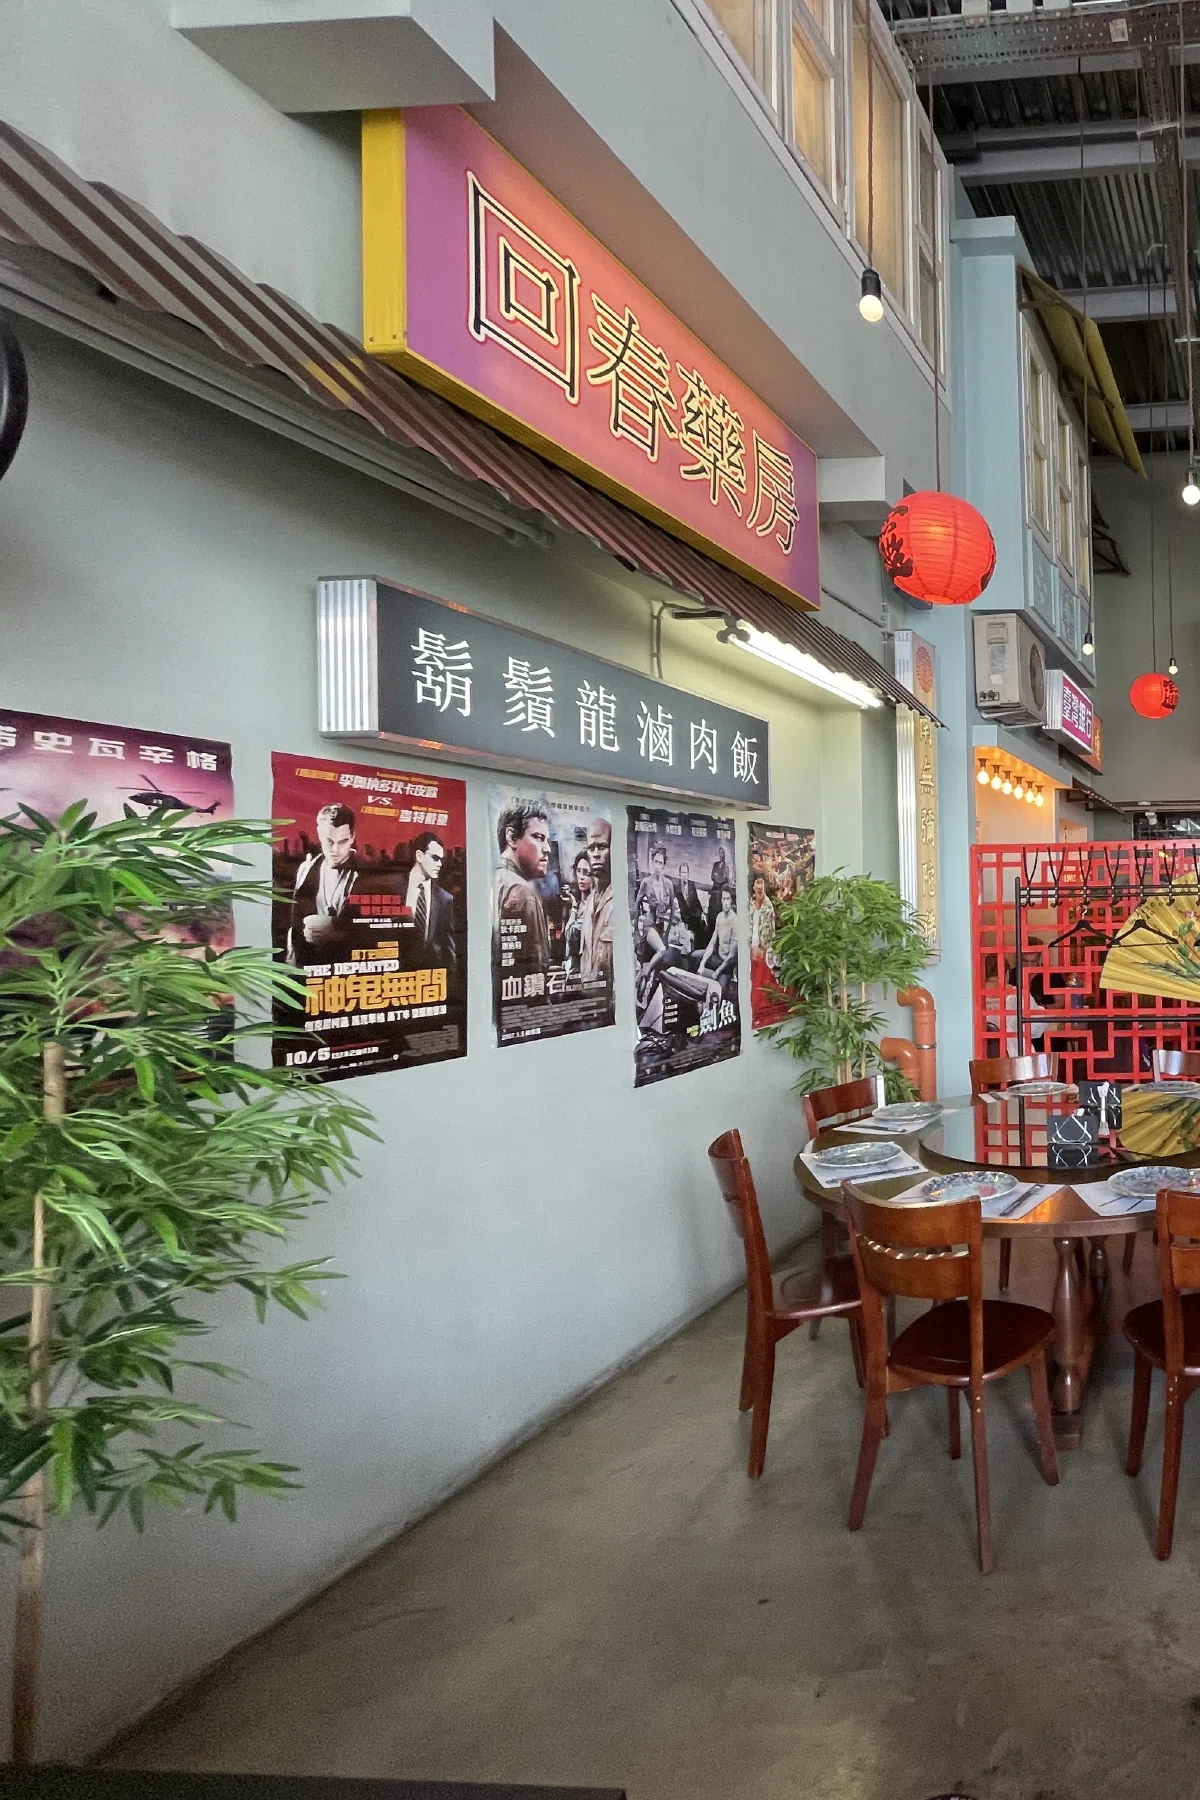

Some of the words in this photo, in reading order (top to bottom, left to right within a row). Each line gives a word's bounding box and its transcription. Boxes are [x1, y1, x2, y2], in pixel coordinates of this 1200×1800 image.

[467, 171, 800, 555] 回春藥房
[410, 627, 760, 785] 鬍鬚龍滷肉飯
[304, 963, 332, 977] THE
[334, 959, 400, 976] DEPARTED
[501, 970, 567, 1001] 血鑽石
[305, 968, 448, 1016] 神鬼無間
[286, 1046, 332, 1067] 10/5
